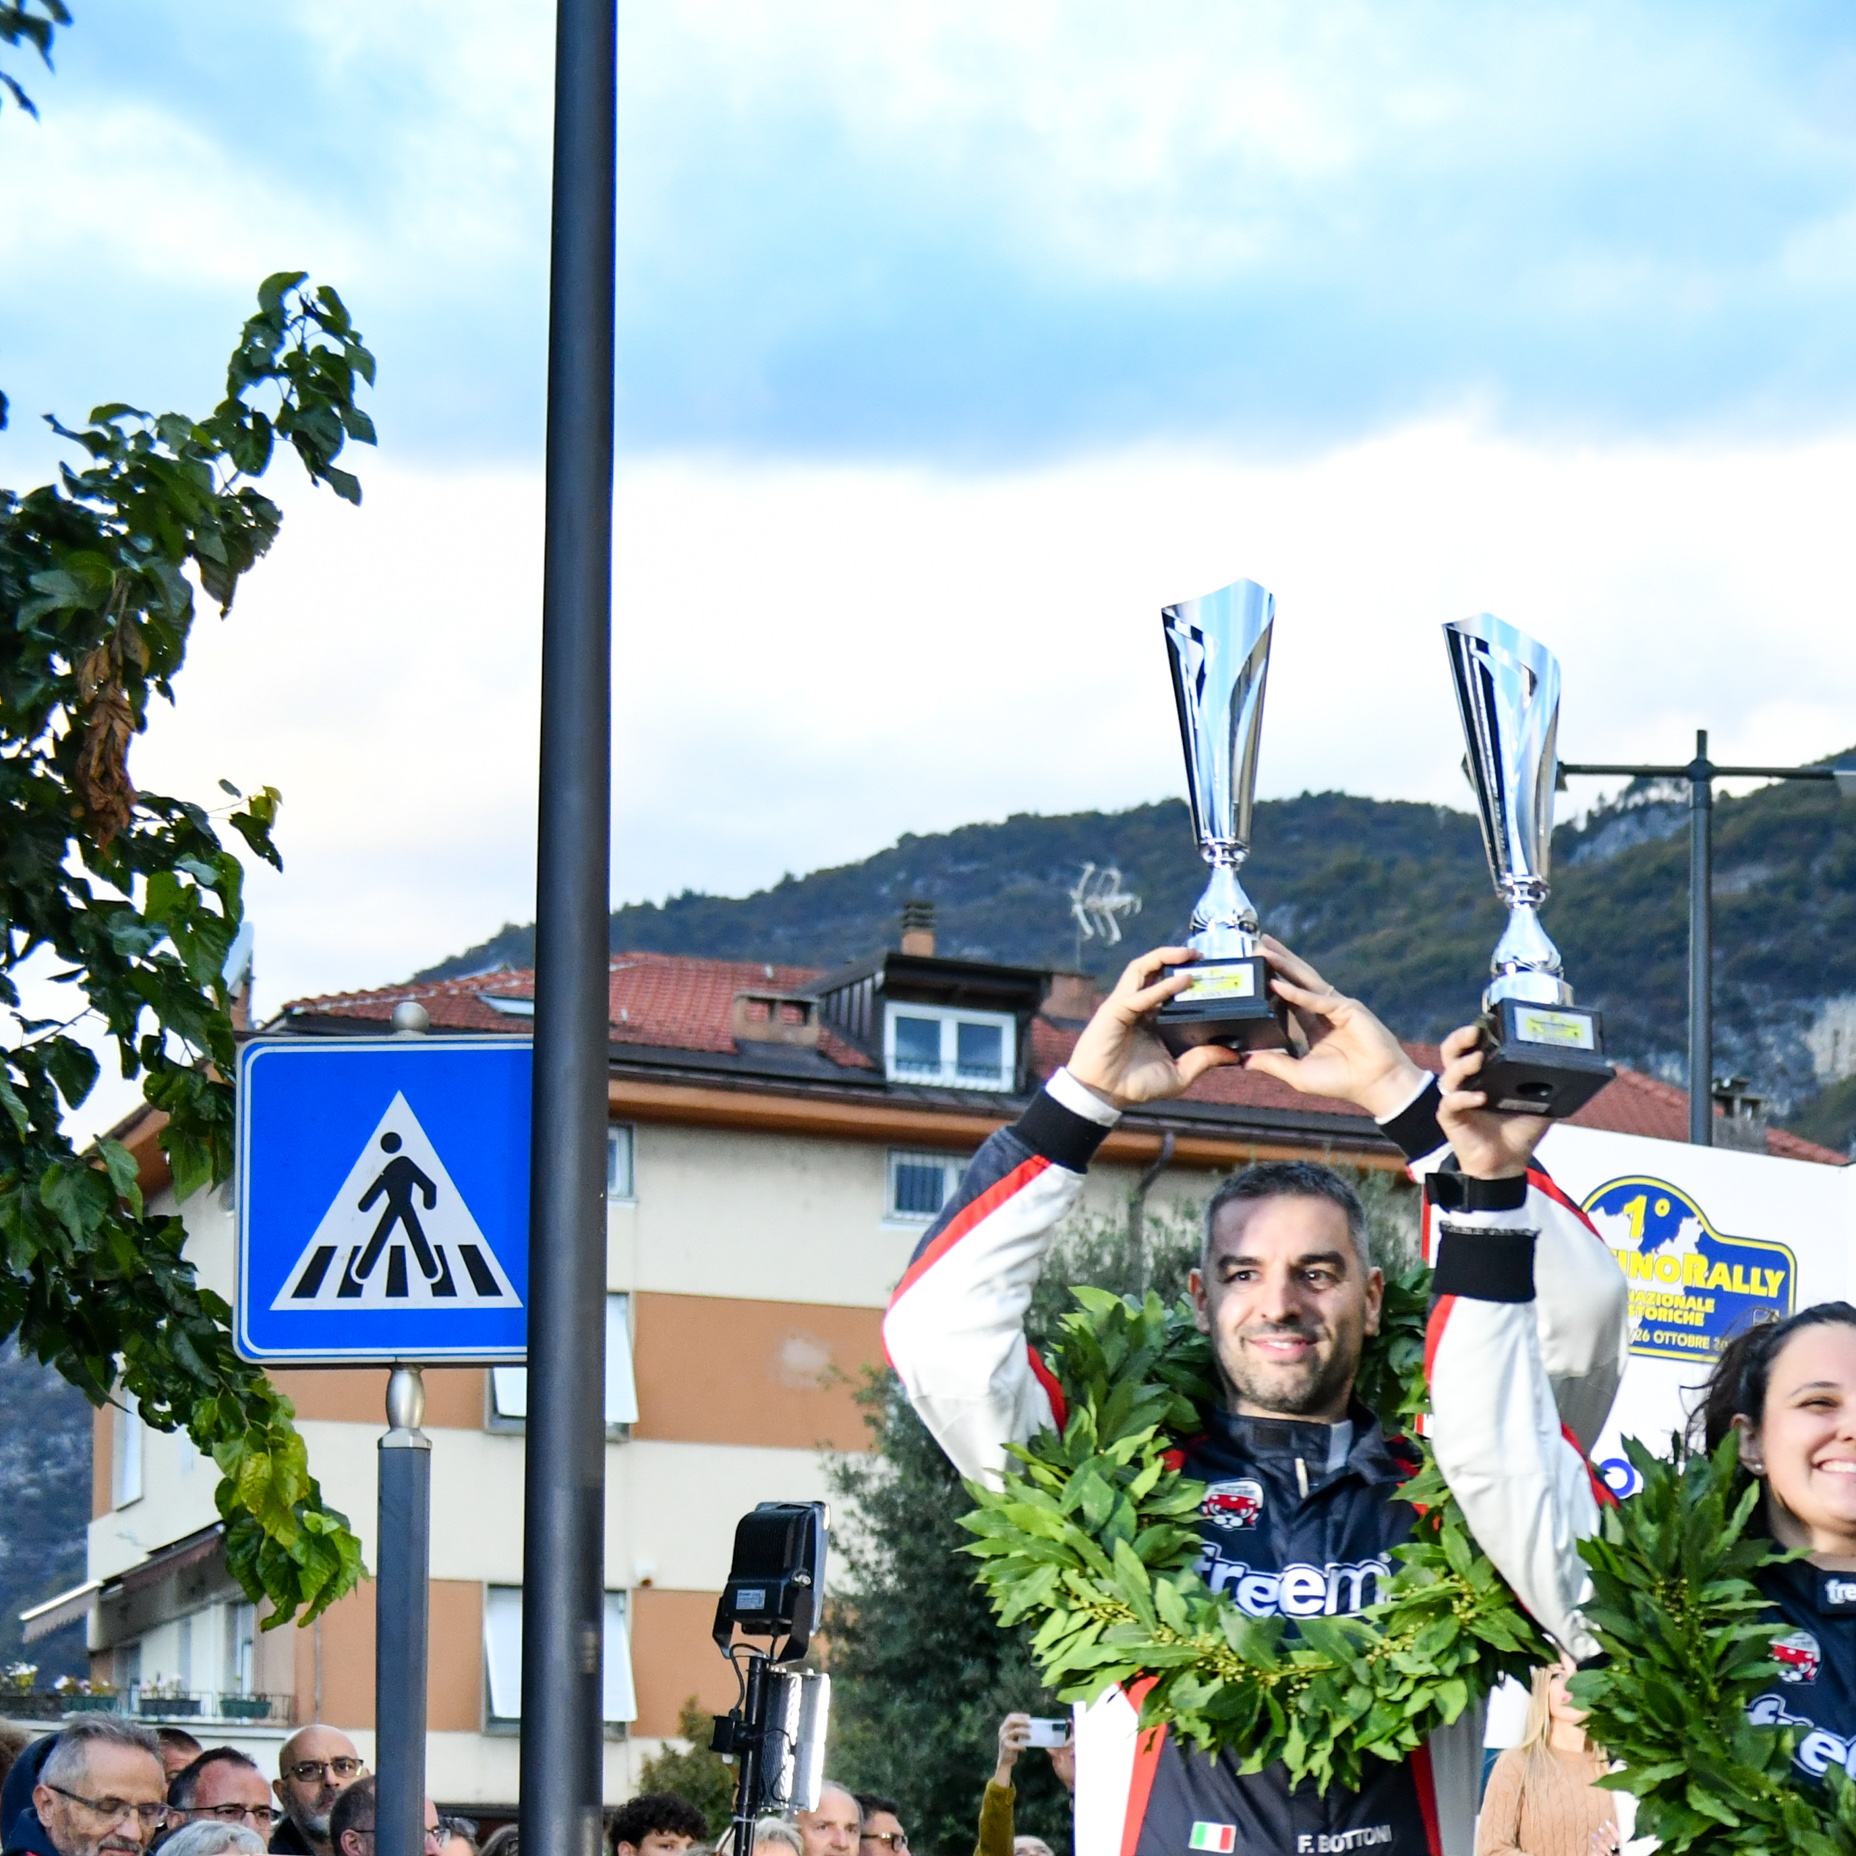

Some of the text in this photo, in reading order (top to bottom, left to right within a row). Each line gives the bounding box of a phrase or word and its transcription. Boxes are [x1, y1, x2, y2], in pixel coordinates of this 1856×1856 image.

[1623, 1194, 1671, 1239] 1°
[1653, 1330, 1710, 1349] OTTOBRE
[1298, 1824, 1392, 1854] F. BOTTONI
